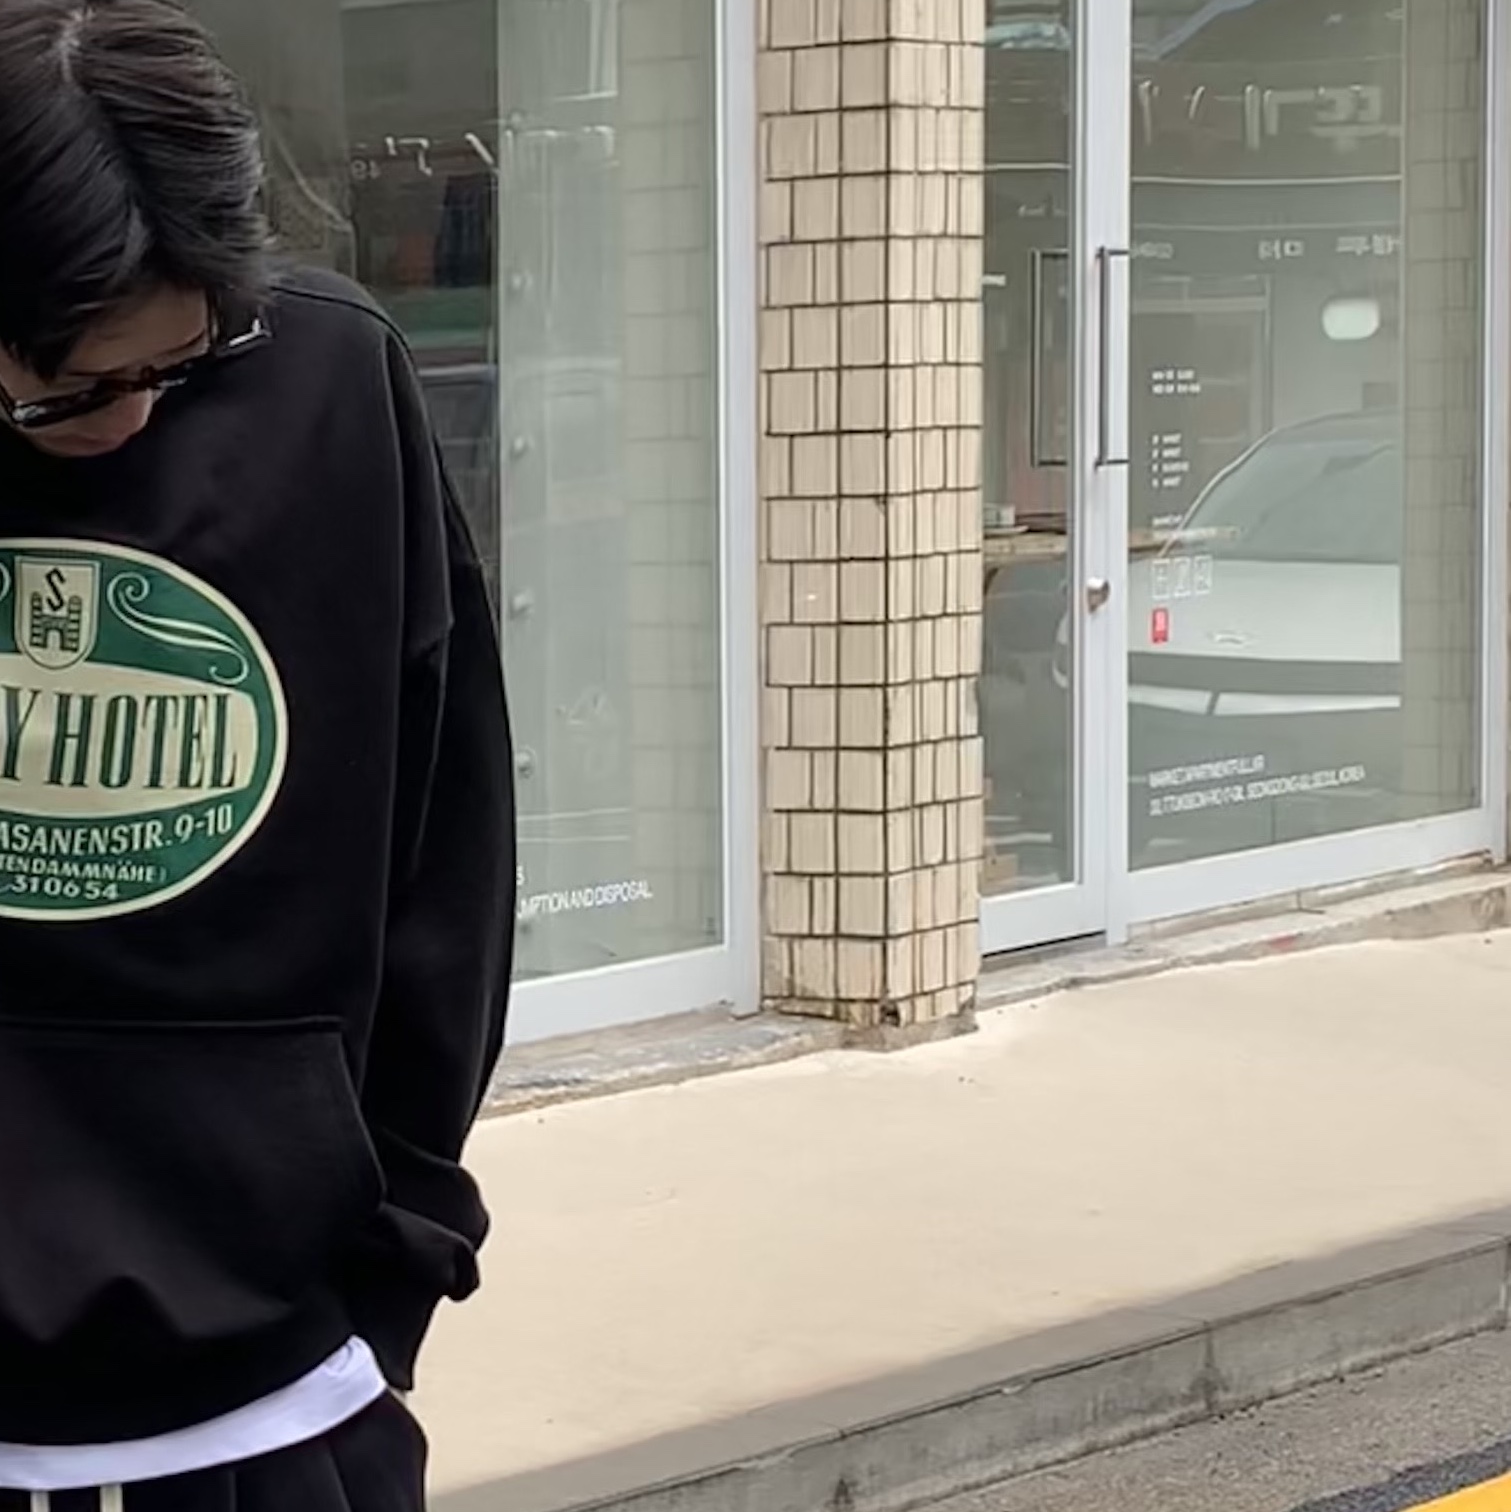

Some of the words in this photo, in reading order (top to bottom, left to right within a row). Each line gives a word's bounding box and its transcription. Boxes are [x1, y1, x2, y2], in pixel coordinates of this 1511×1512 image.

[45, 567, 66, 612] S
[44, 690, 239, 791] HOTEL
[174, 803, 233, 846] 9-10
